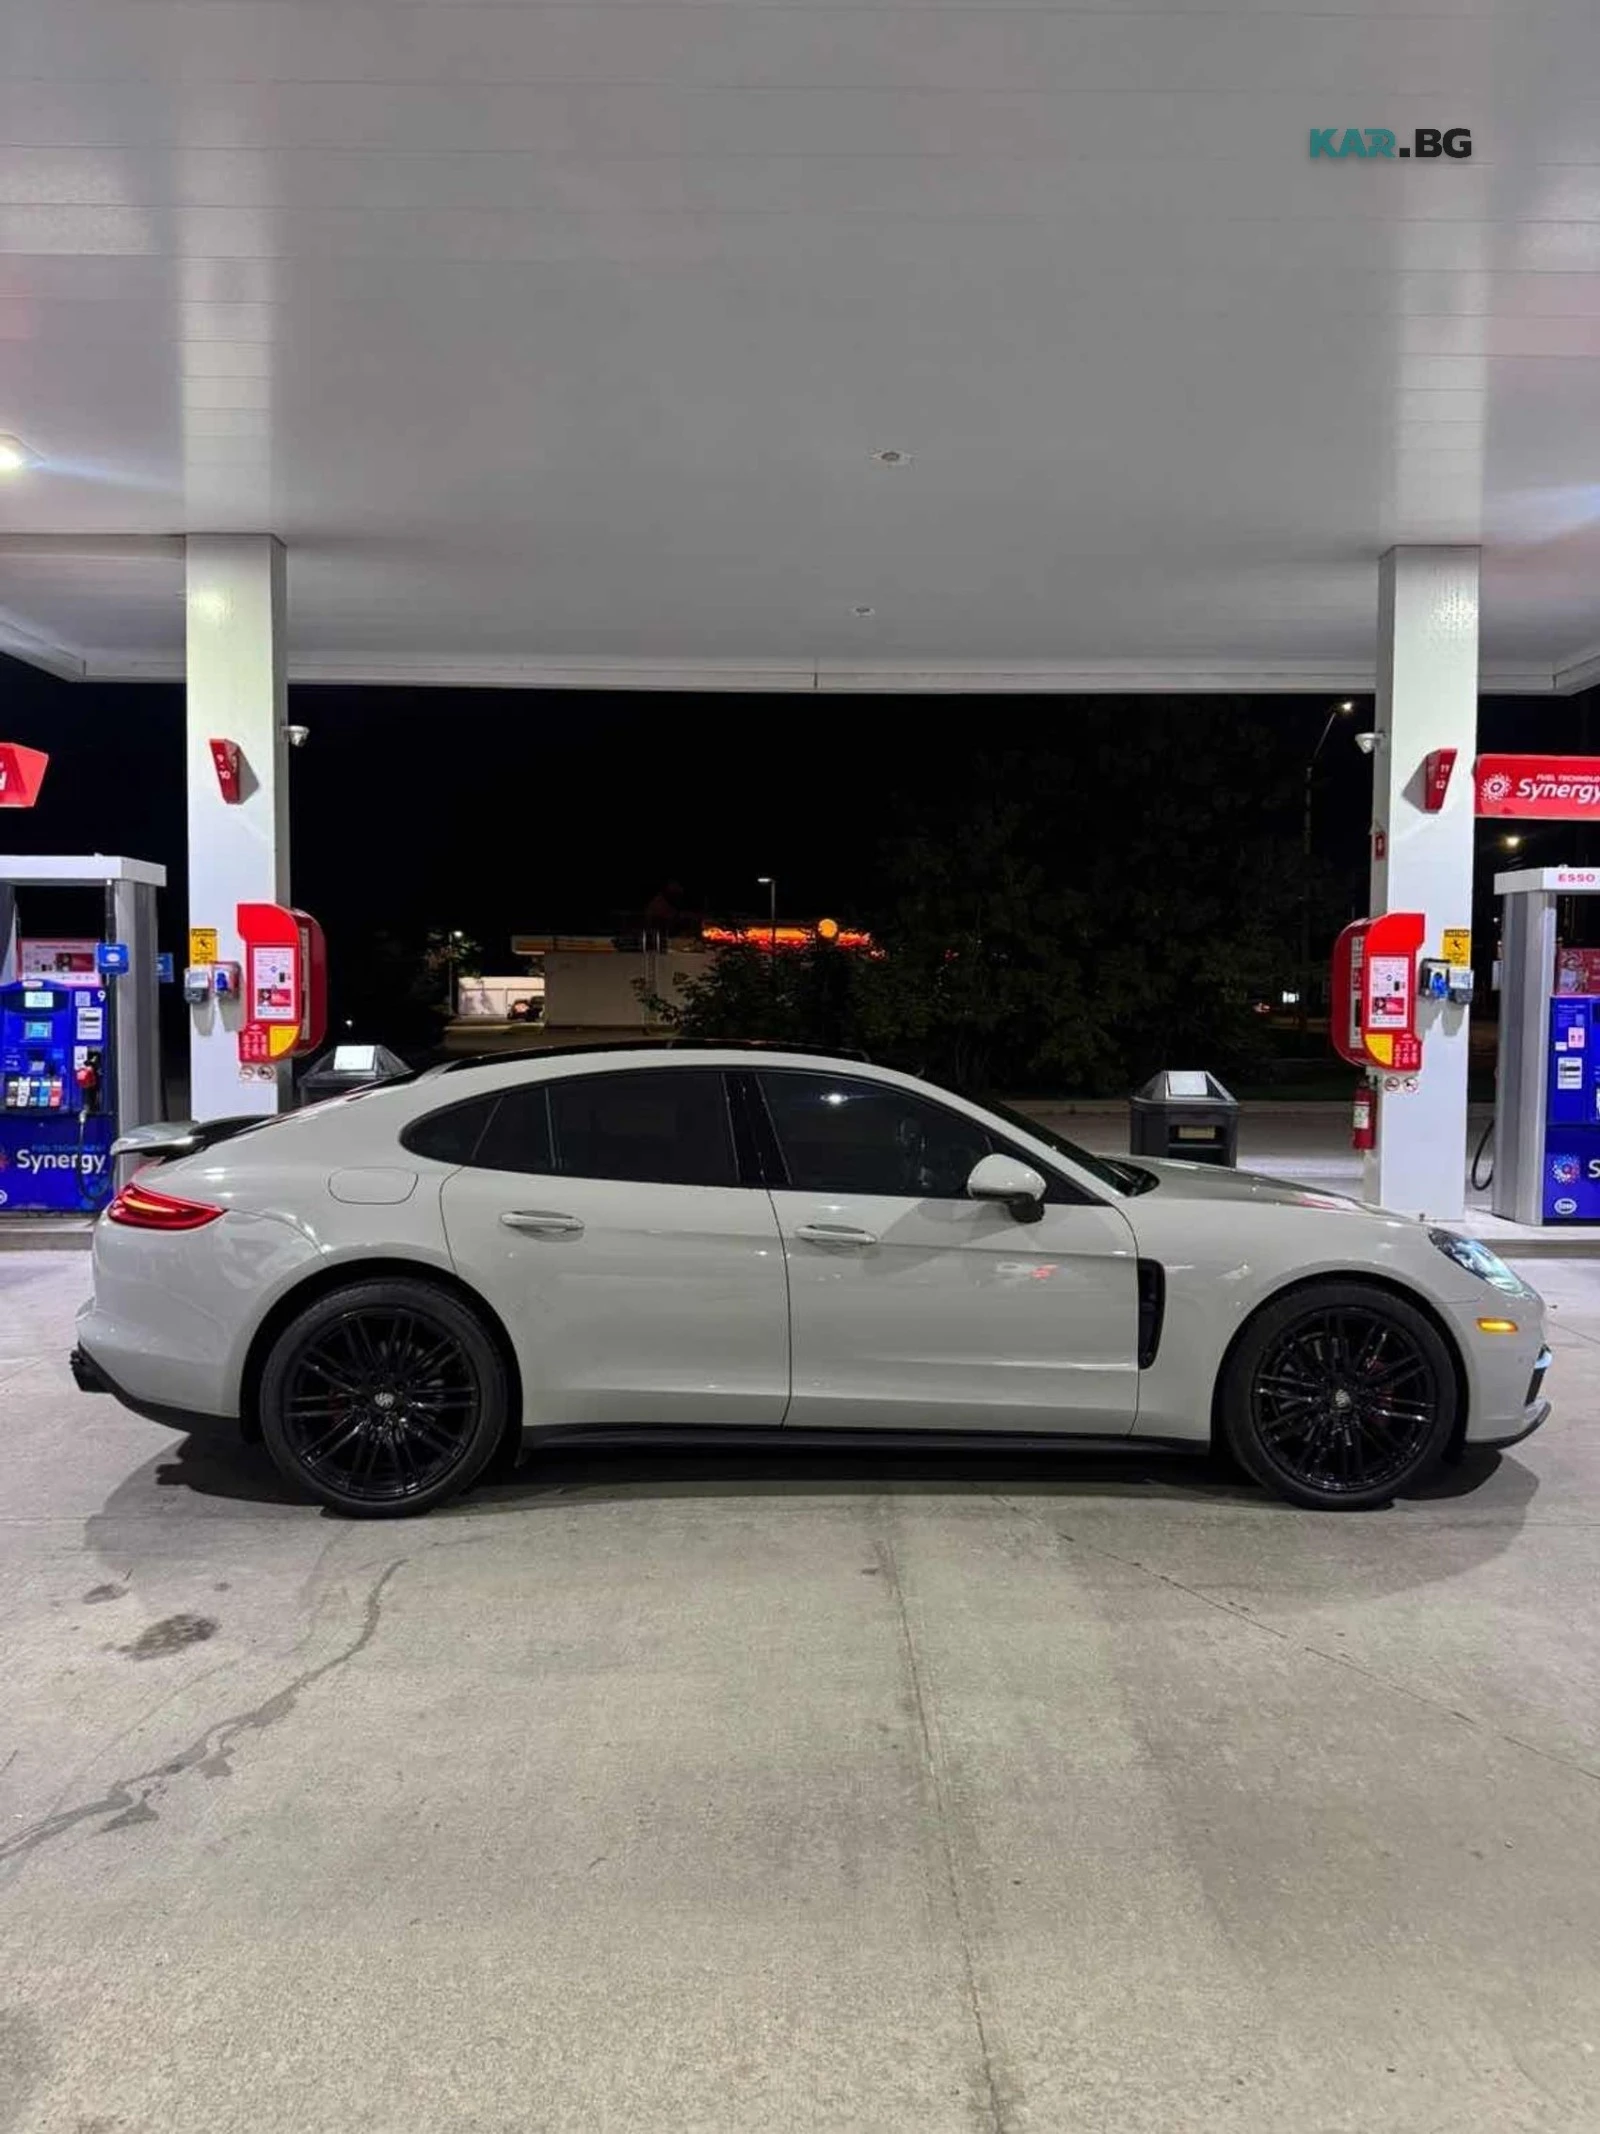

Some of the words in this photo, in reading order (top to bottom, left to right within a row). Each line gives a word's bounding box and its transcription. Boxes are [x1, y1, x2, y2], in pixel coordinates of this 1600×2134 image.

[1557, 873, 1596, 883] ESSO
[97, 990, 107, 1003] 9
[16, 1149, 107, 1175] Synergy
